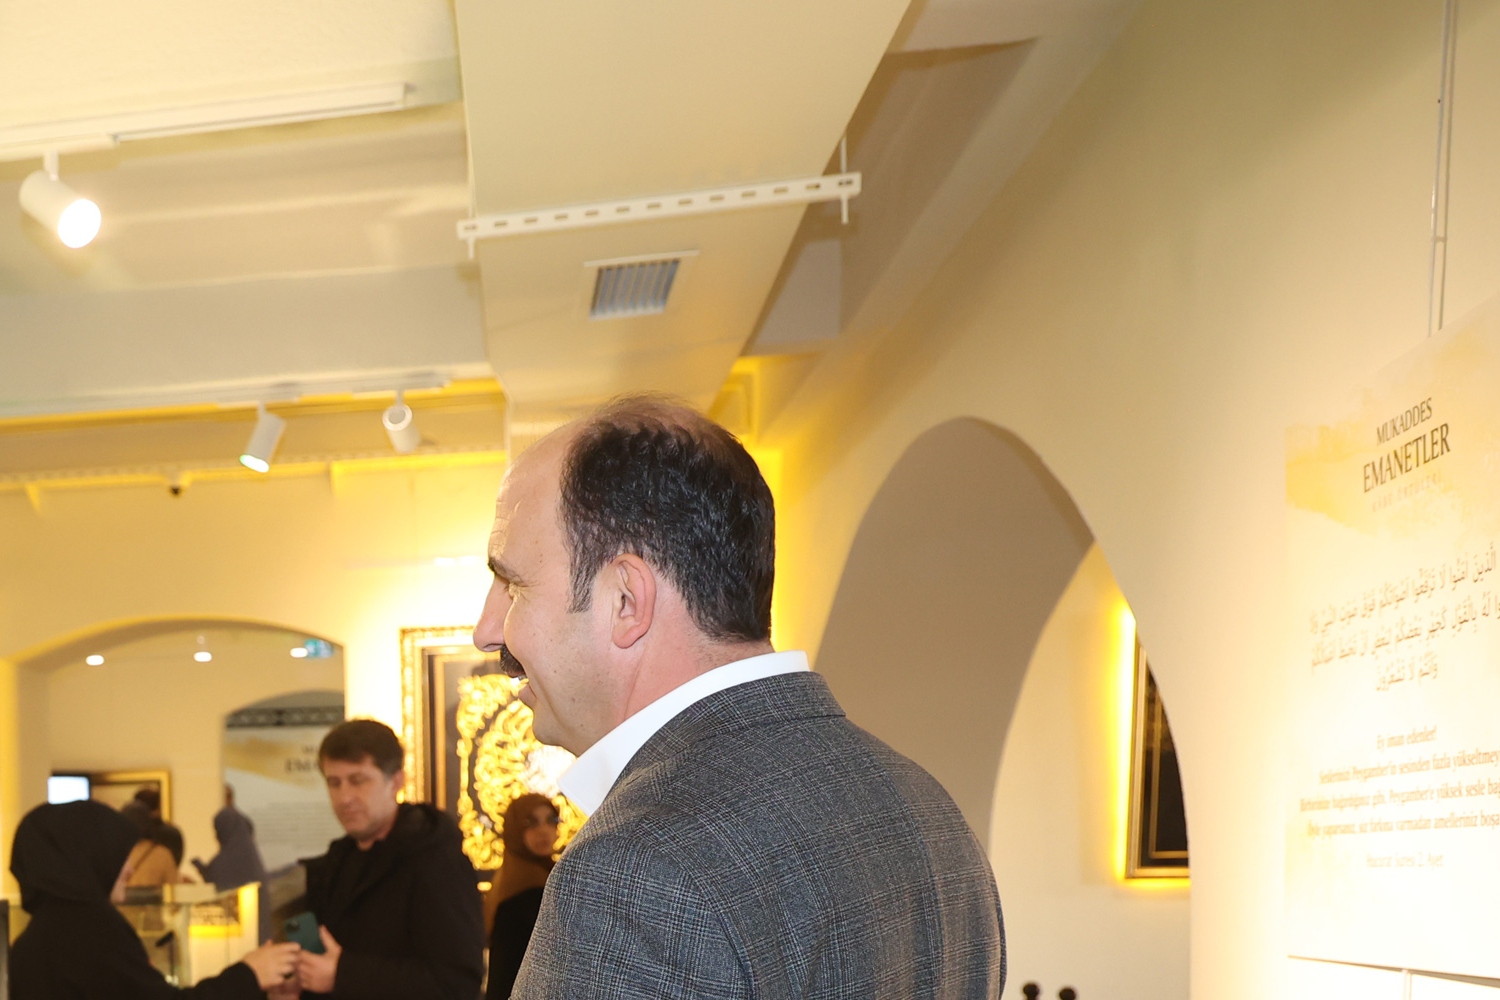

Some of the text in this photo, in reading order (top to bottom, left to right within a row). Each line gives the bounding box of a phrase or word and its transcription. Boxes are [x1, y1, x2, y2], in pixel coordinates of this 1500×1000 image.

[1376, 397, 1433, 446] MUKADDES
[1363, 423, 1451, 493] EMANETLER
[1452, 747, 1500, 772] yükseltmey
